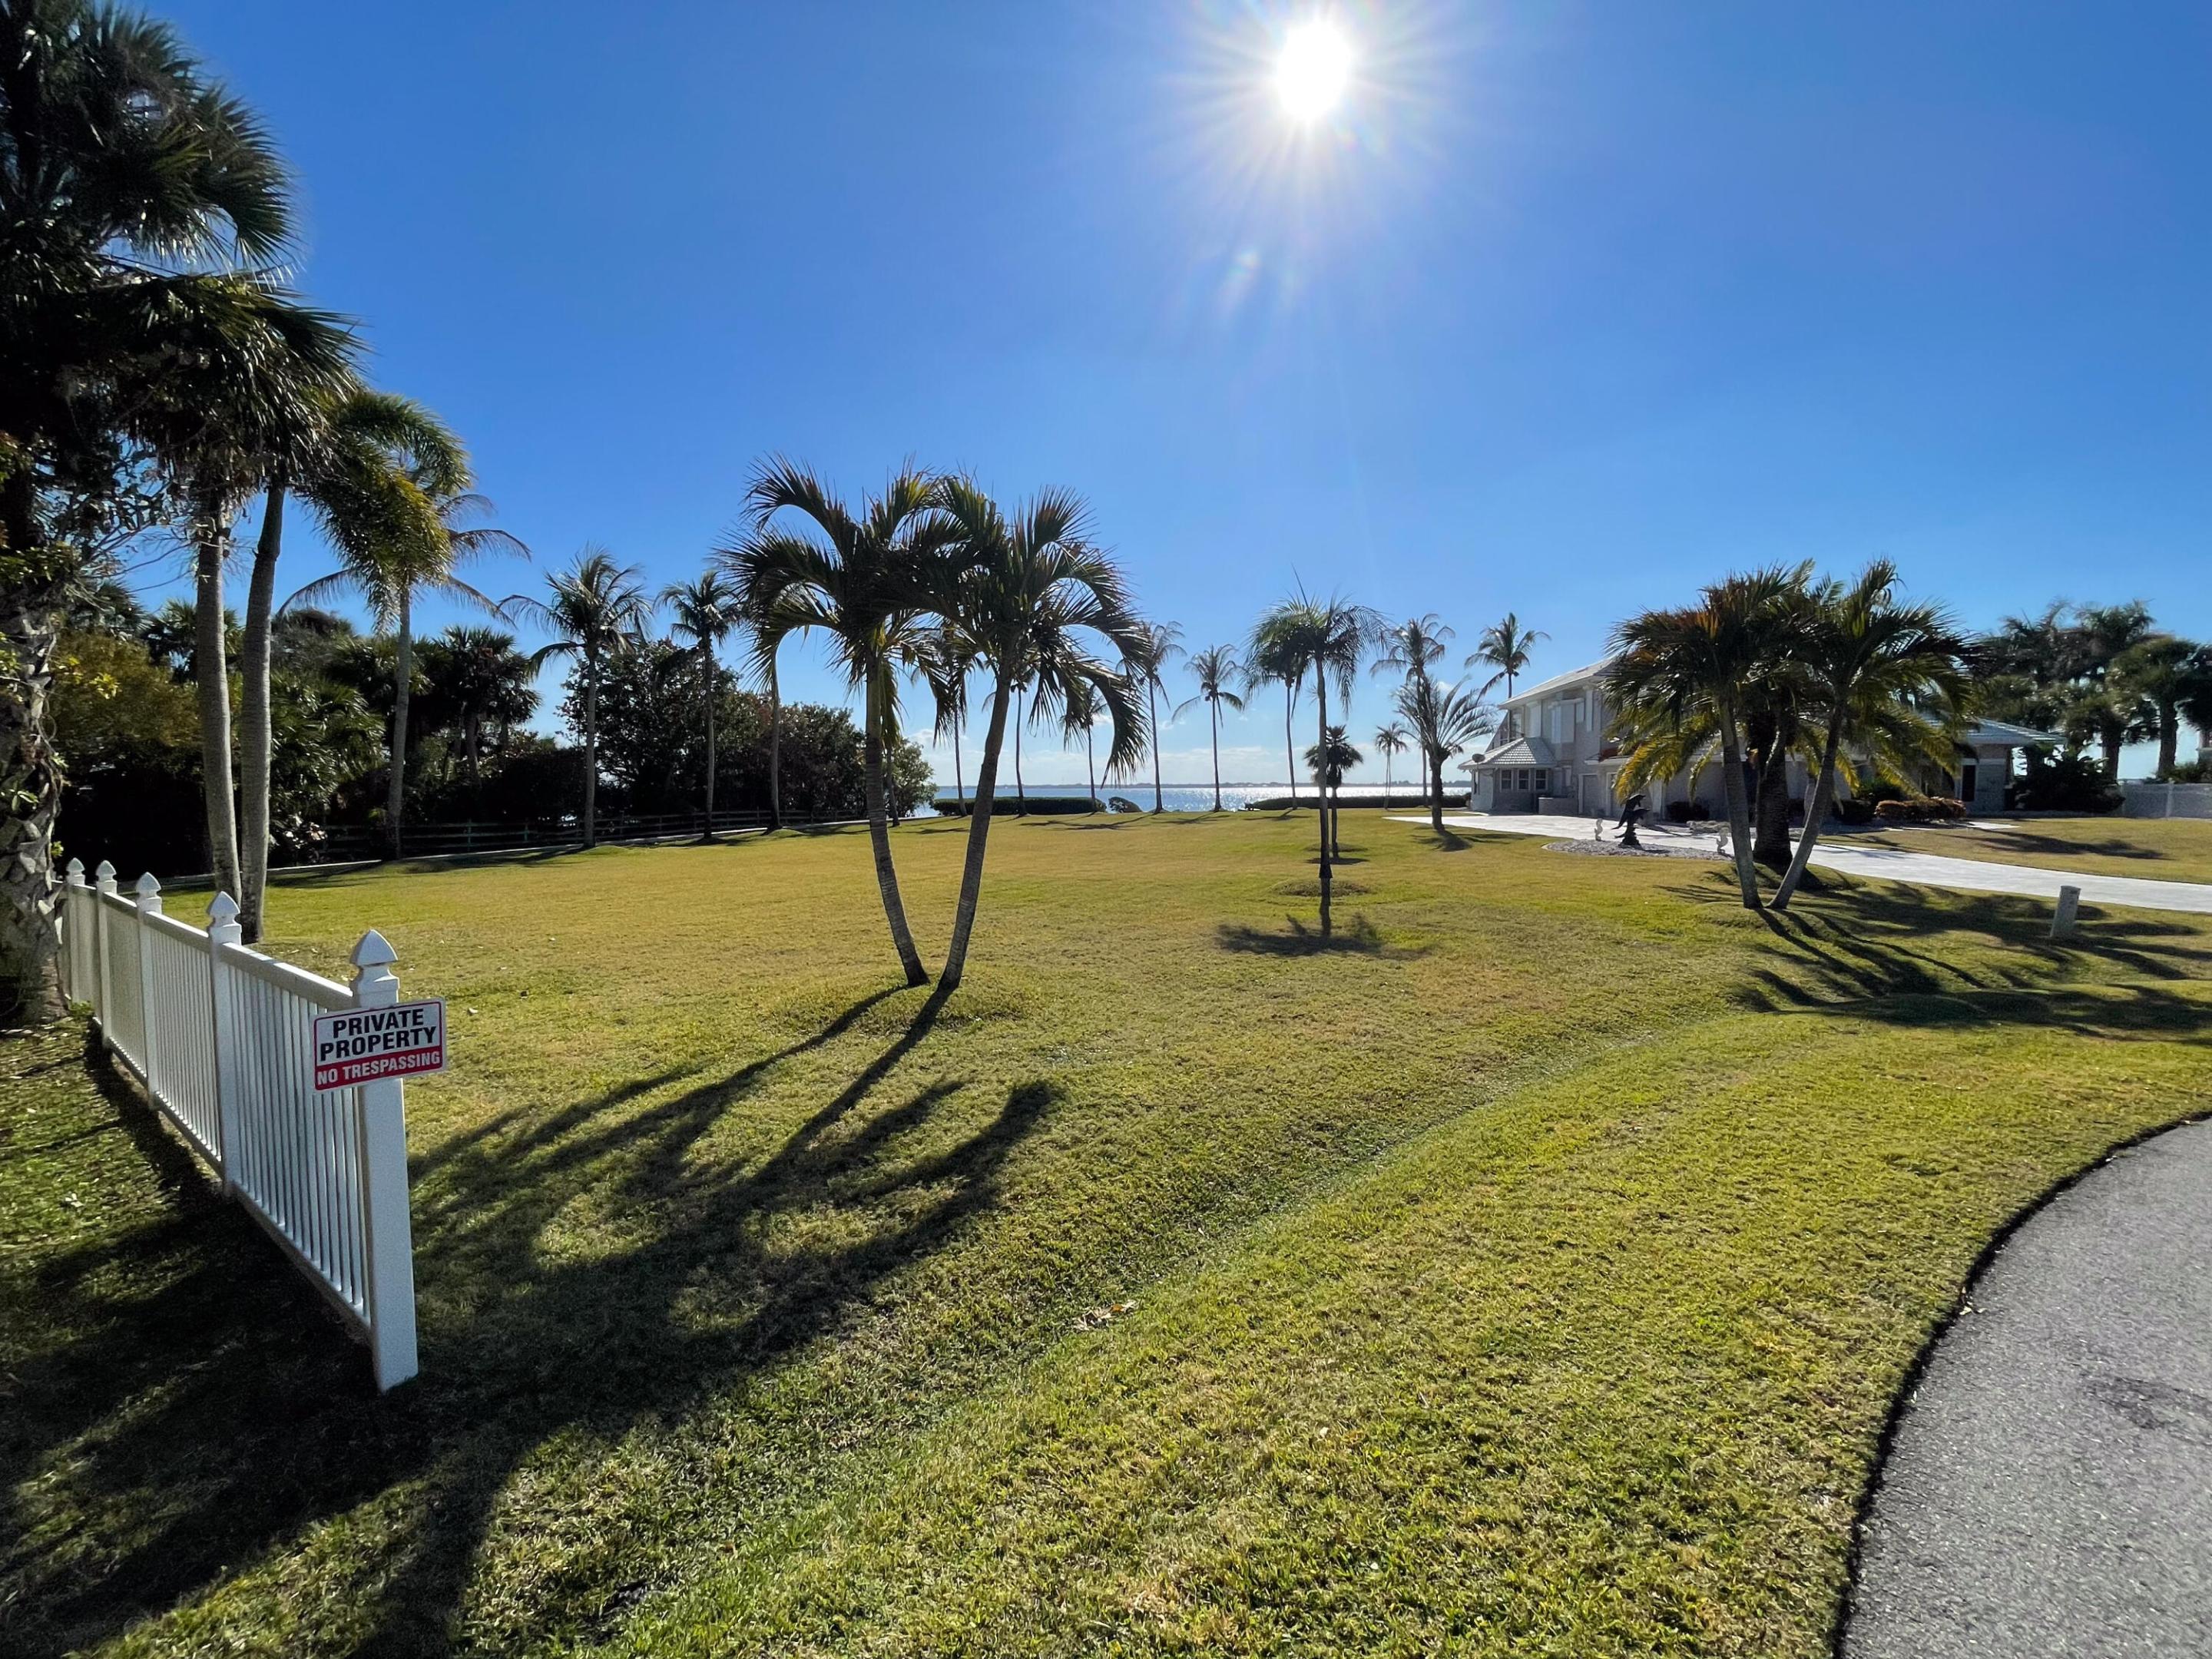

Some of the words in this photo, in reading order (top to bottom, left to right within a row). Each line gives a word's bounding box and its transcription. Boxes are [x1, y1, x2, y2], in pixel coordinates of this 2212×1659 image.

[333, 1008, 424, 1038] PRIVATE
[320, 1026, 436, 1061] PROPERTY
[317, 1068, 338, 1085] NO
[343, 1051, 440, 1081] TRESPASSING
